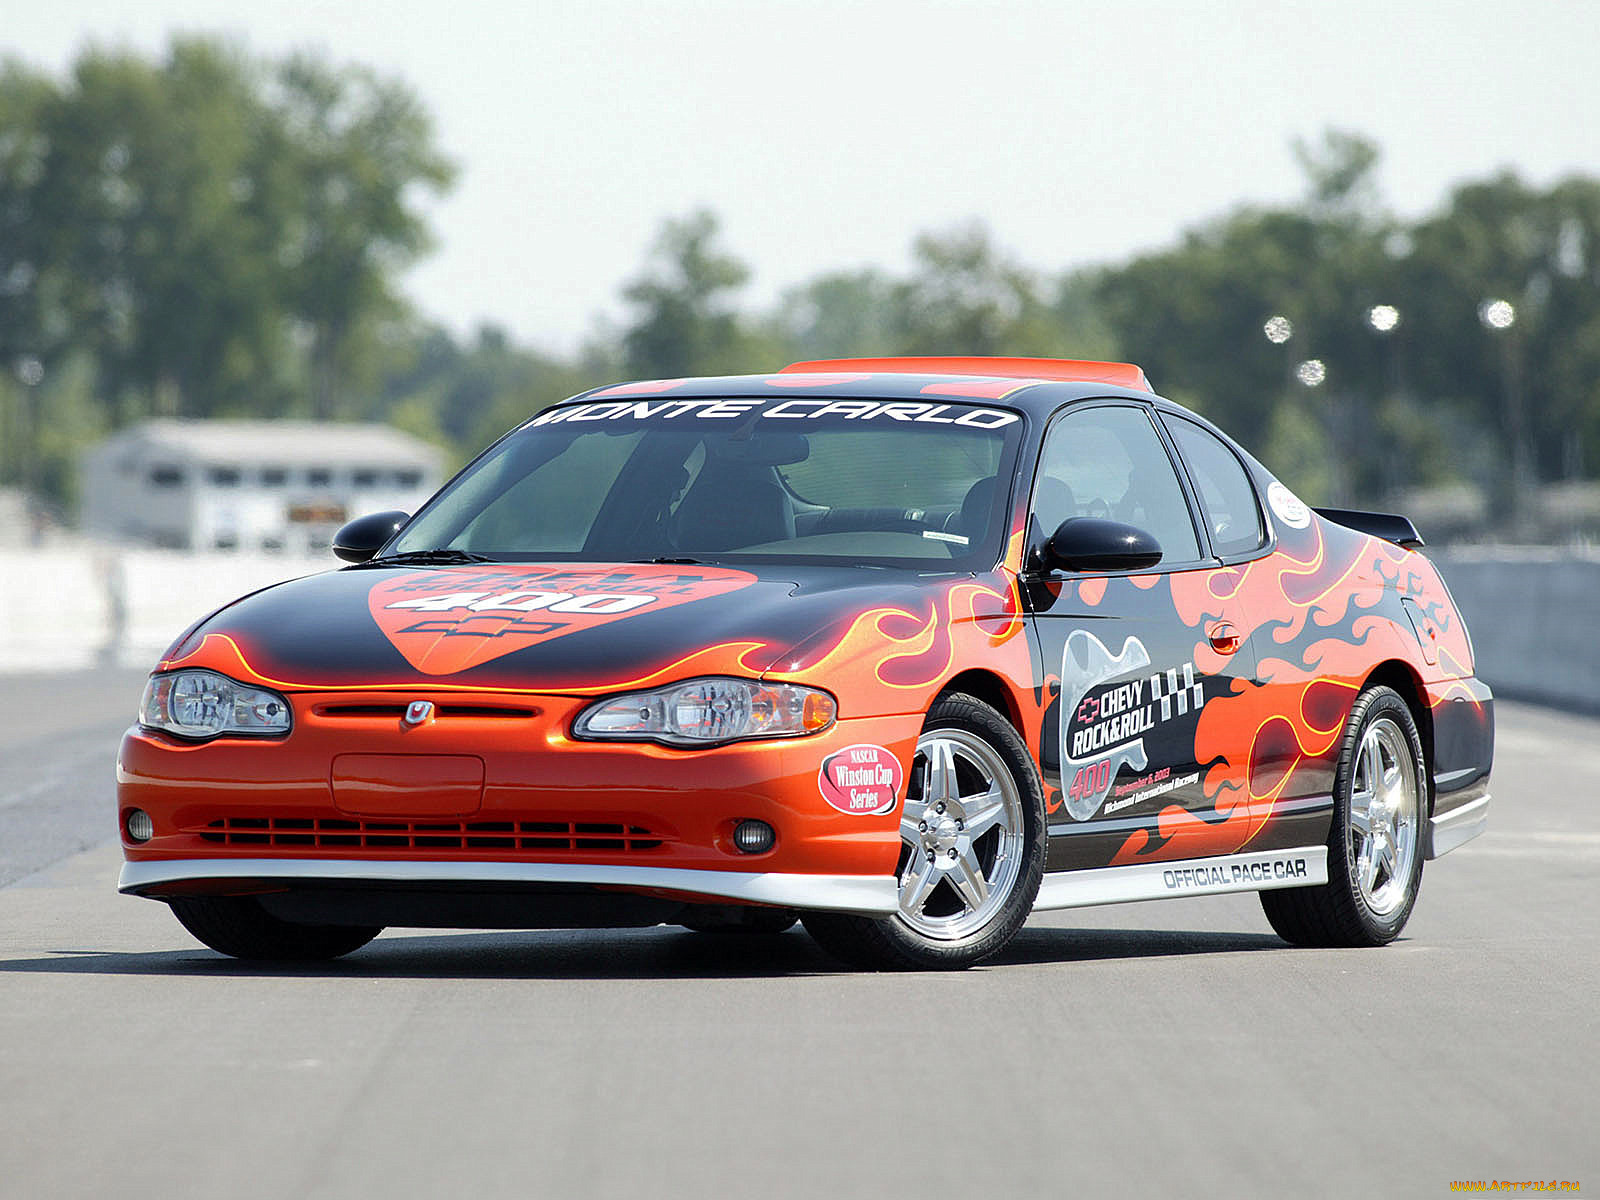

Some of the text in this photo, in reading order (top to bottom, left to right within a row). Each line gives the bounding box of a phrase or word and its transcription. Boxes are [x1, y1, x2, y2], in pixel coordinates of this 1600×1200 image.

[519, 400, 1019, 429] MONTE CARLO
[384, 590, 657, 614] 400
[1100, 679, 1145, 719] CHEVY
[1071, 704, 1155, 758] ROCK&ROLL
[850, 749, 879, 763] NASCAR
[835, 763, 893, 787] Winston Cup
[1068, 758, 1112, 802] 400
[1114, 776, 1148, 797] September
[849, 788, 878, 809] Series
[1104, 772, 1200, 815] Richmond International Raceway
[1163, 858, 1307, 889] OFFICIAL PACE CAR
